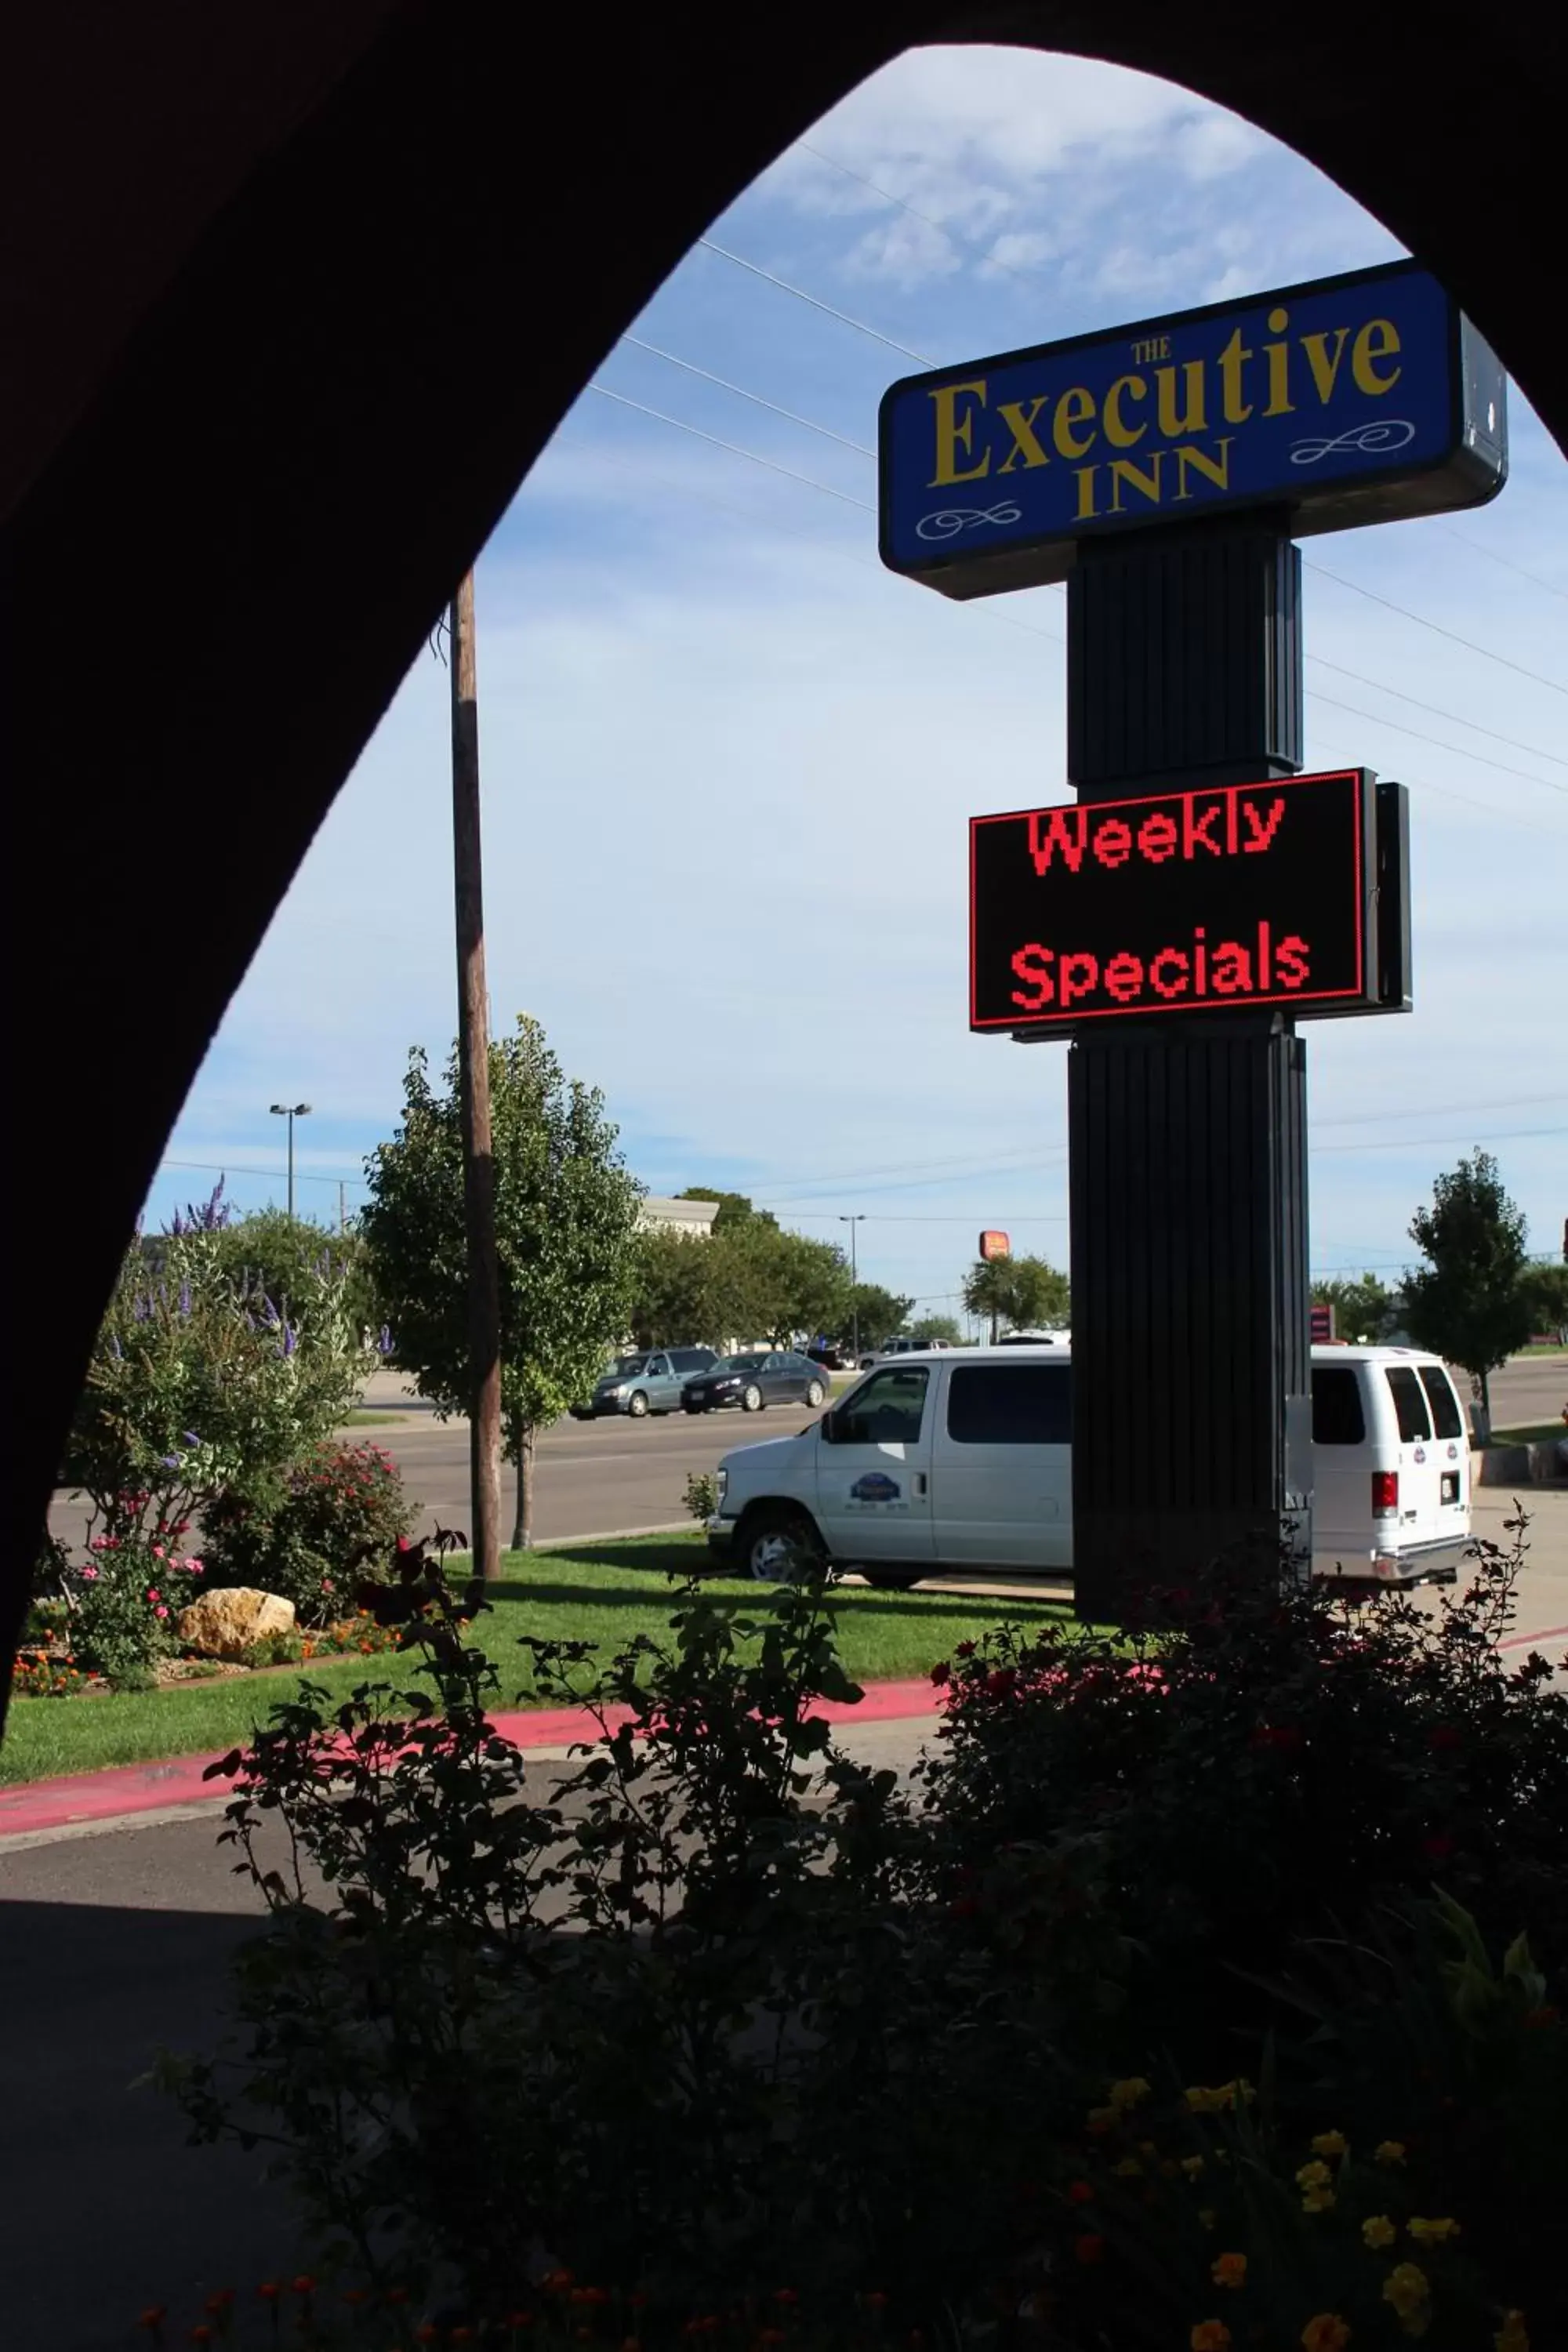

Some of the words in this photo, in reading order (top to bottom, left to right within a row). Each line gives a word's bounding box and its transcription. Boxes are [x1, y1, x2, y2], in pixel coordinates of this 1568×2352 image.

[1131, 336, 1171, 365] THE
[927, 308, 1402, 488] Executive
[1073, 437, 1236, 521] INN
[1028, 787, 1285, 876] Weekly
[1011, 921, 1310, 1010] Specials
